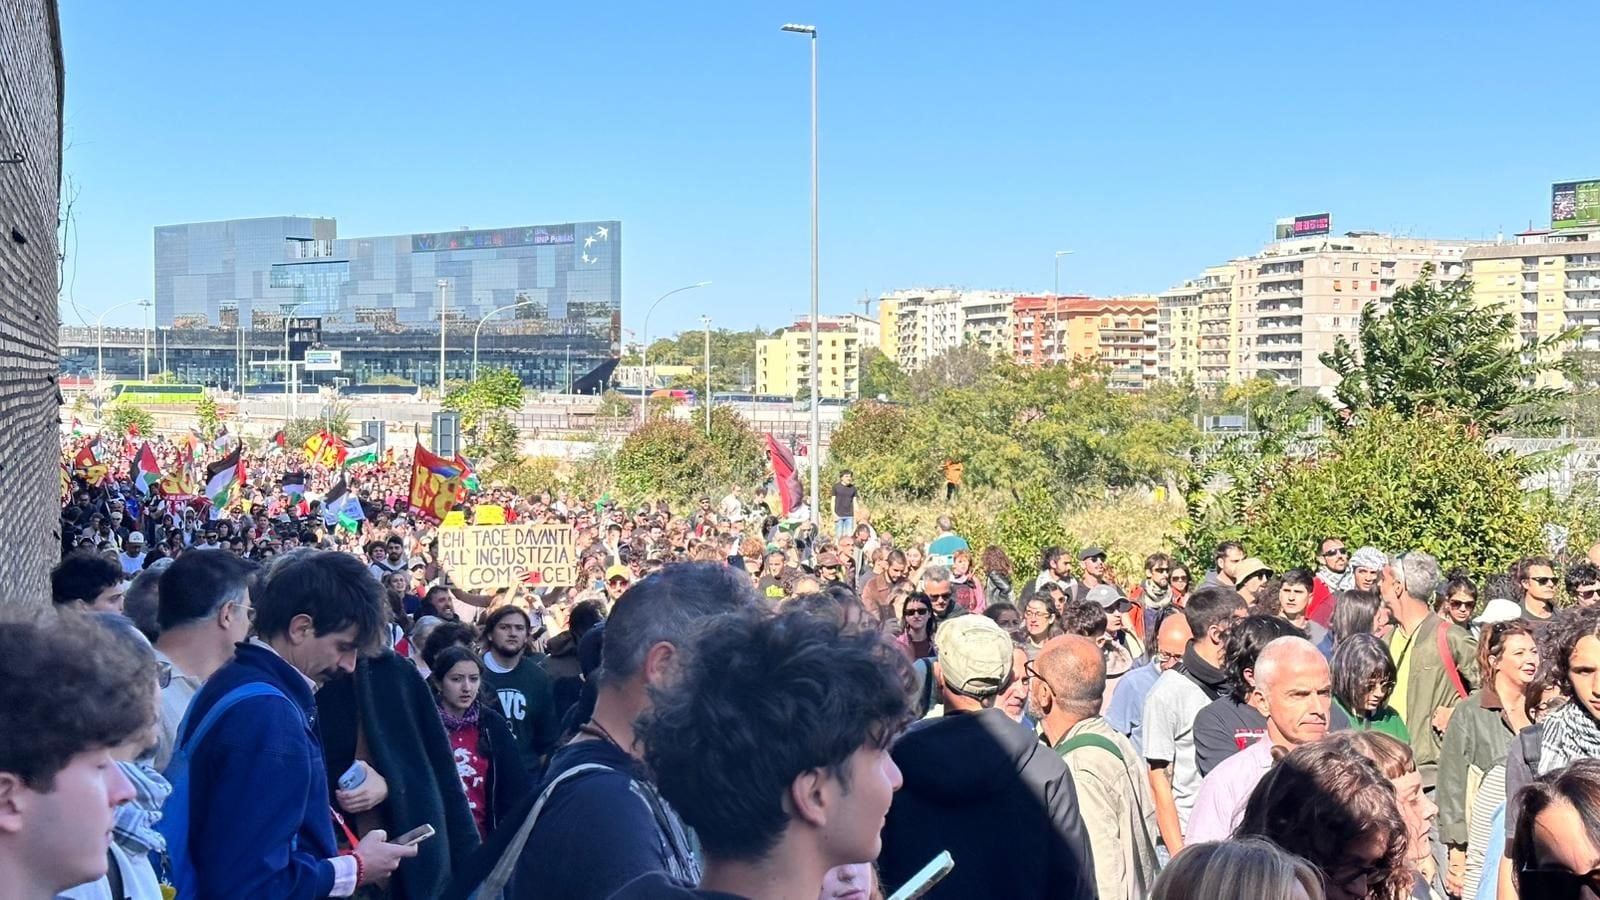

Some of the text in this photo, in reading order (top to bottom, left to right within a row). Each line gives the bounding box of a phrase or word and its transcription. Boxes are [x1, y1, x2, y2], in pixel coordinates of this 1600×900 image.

[442, 528, 572, 548] CHI TACE DAVANTI
[475, 546, 569, 566] INGIUSTIZIA
[469, 566, 572, 585] COMPCE!
